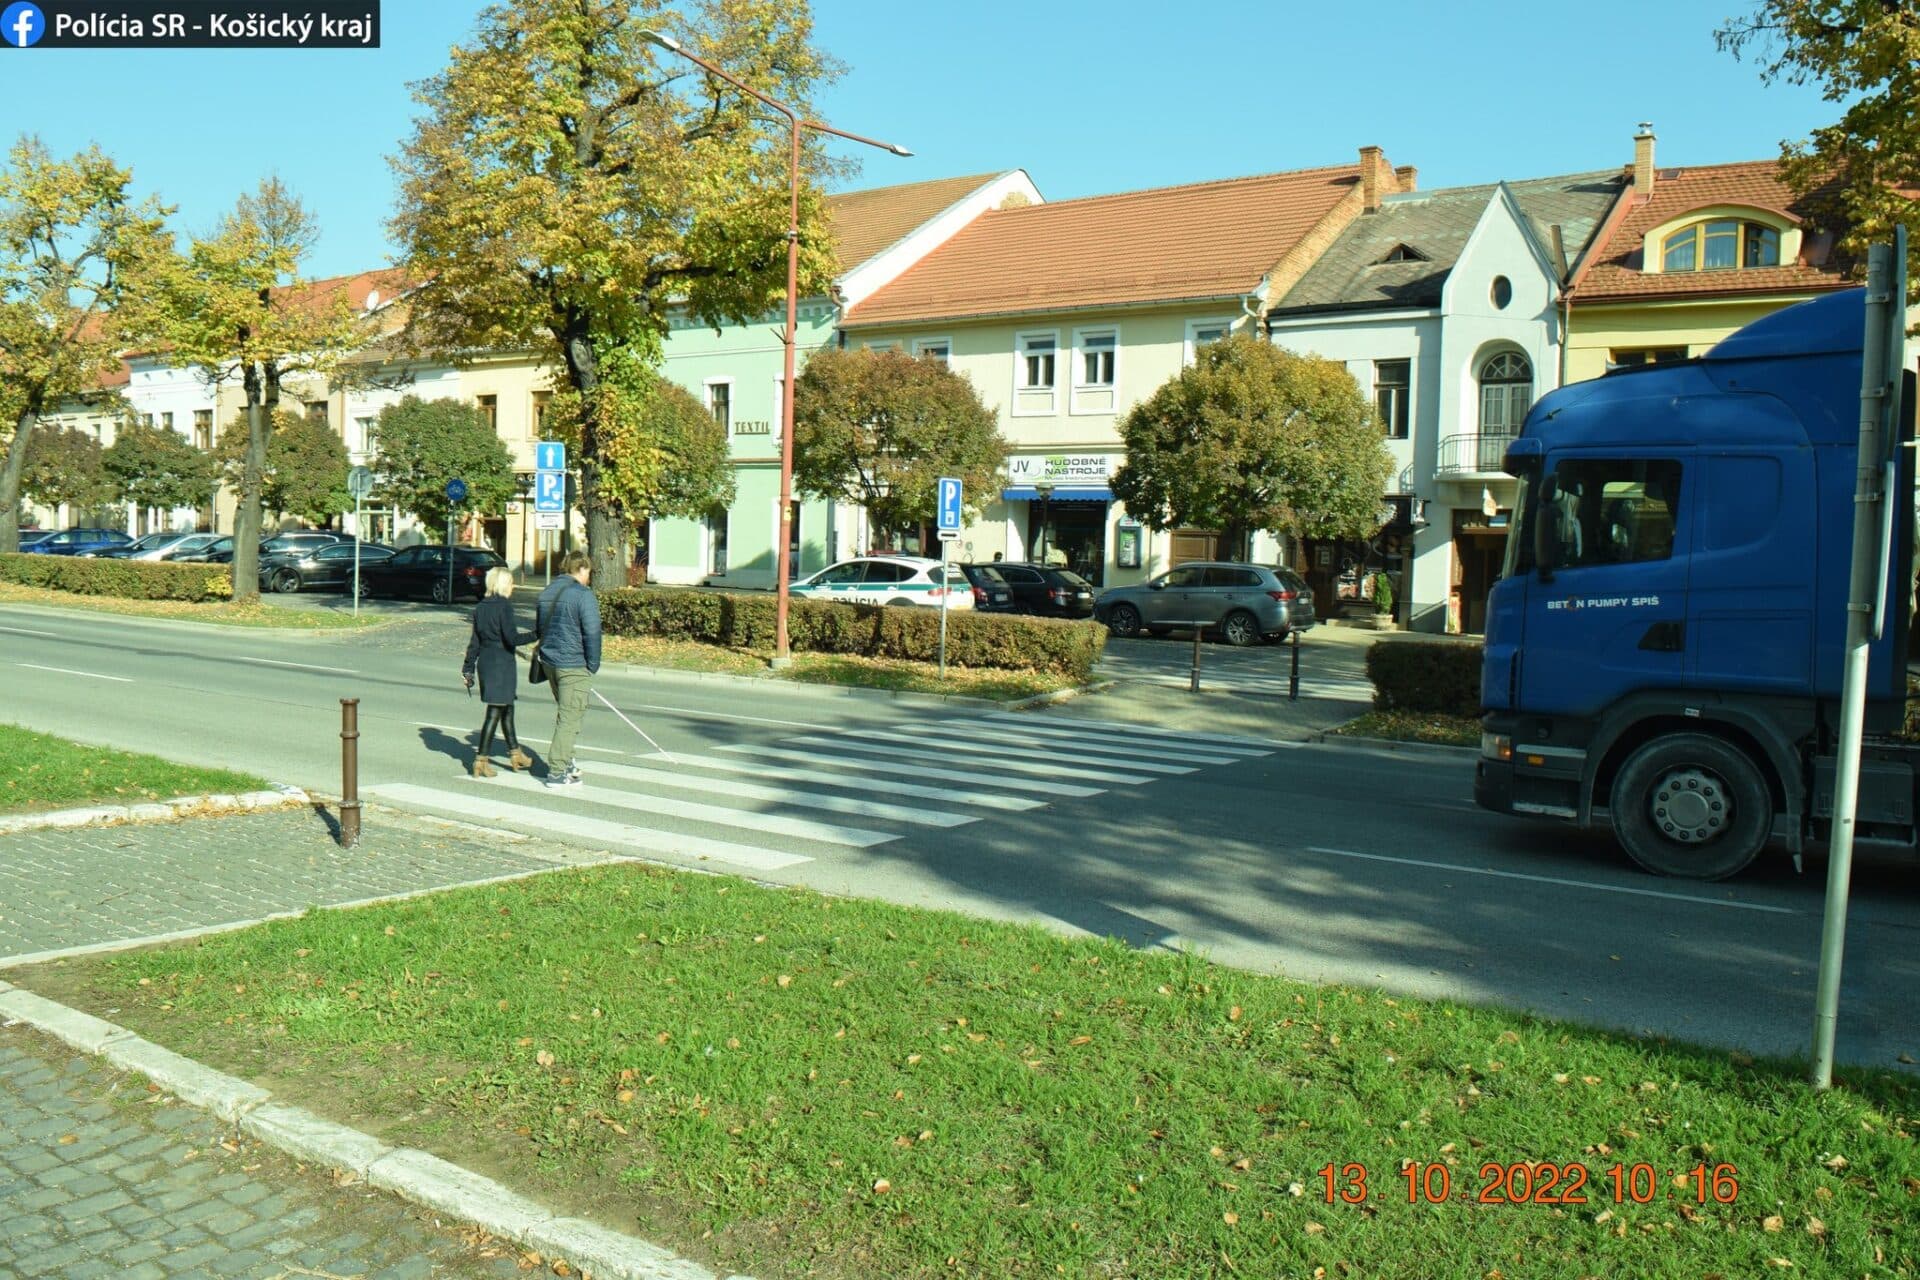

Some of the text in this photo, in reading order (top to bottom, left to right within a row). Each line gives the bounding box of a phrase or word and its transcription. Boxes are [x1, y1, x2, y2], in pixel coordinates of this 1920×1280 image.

[735, 421, 770, 434] TEXTIL
[1013, 460, 1030, 473] JV
[543, 474, 557, 497] P
[945, 482, 956, 510] P
[1588, 598, 1628, 607] PUMPY
[1631, 596, 1660, 606] SPIŠ
